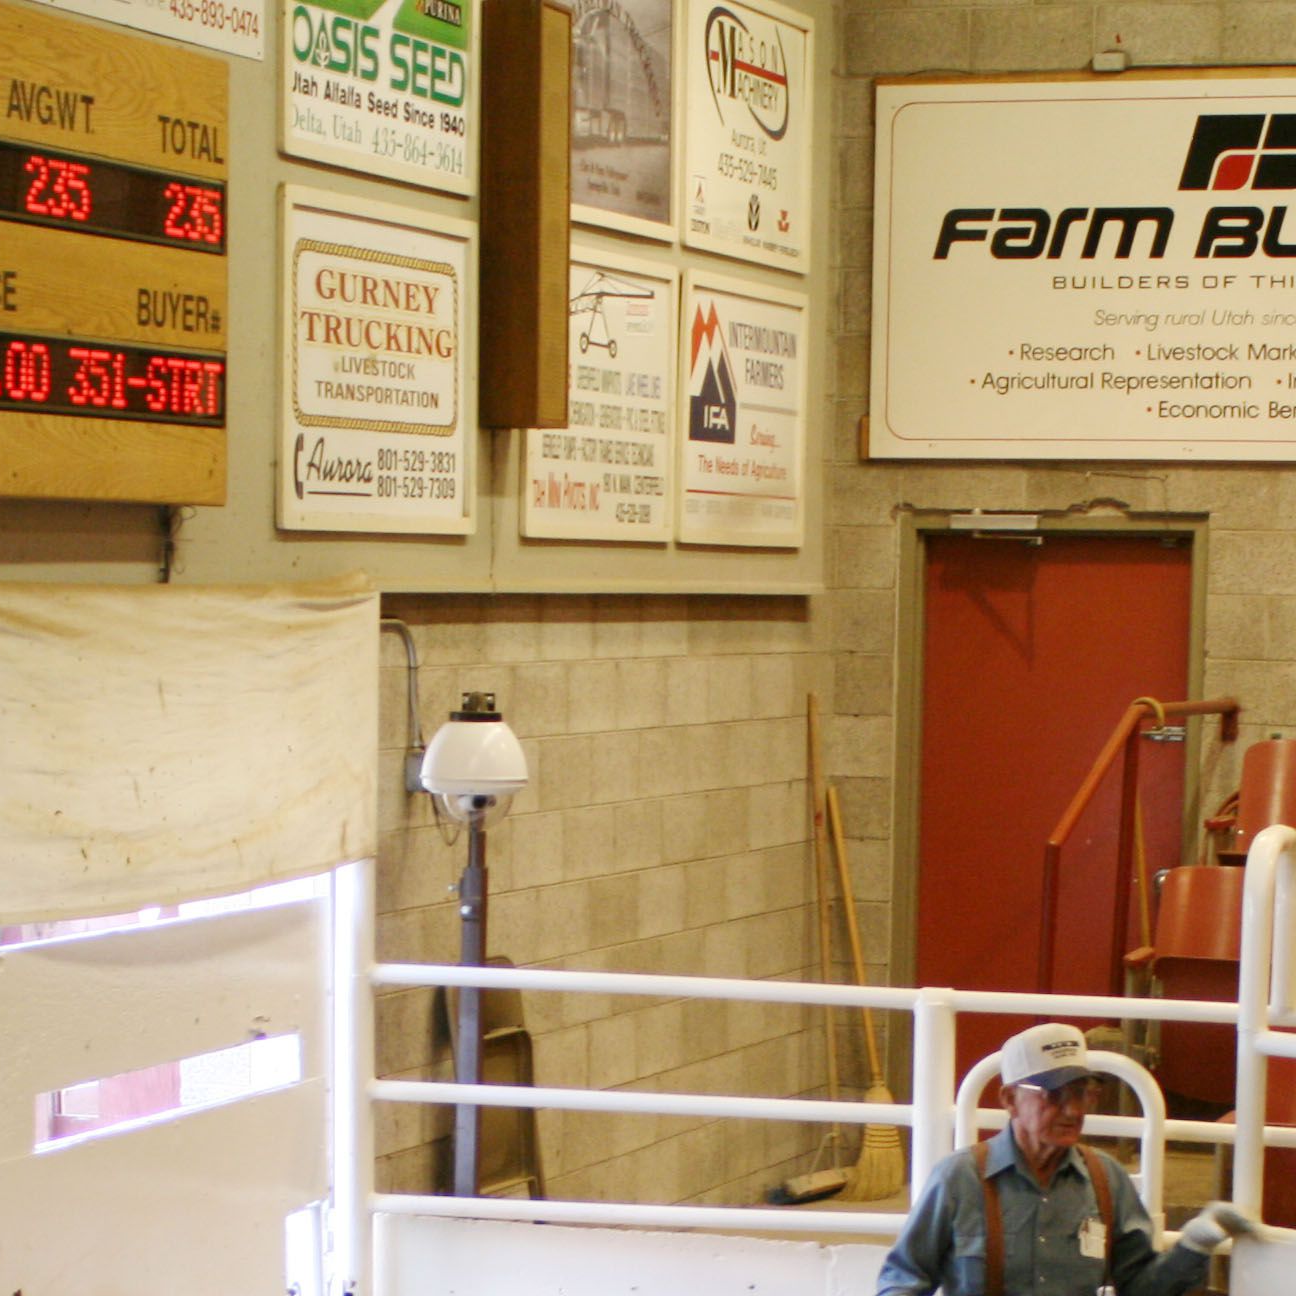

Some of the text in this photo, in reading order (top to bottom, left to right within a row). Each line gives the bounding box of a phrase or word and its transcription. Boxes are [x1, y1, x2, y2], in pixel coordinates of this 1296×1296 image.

[292, 5, 465, 108] OASIS SEED
[324, 79, 361, 109] Alfalfa
[367, 92, 398, 119] Seed
[404, 101, 435, 129] Since
[440, 112, 465, 138] 1940
[158, 115, 225, 165] TOTAL
[333, 114, 363, 145] Utah
[371, 127, 463, 175] 435-864-3614
[315, 268, 440, 315] GURNEY
[1052, 275, 1191, 290] BUILDERS
[1202, 275, 1238, 290] OF
[137, 288, 222, 333] BUYER#
[1093, 308, 1160, 332] Serving
[1164, 309, 1205, 327] rural
[1211, 309, 1255, 327] Utah
[300, 310, 454, 358] TRUCKING
[1019, 343, 1115, 361] Research
[1146, 343, 1240, 361] Livestock
[341, 356, 415, 380] LIVESTOCK
[744, 357, 785, 391] FARMERS
[315, 380, 439, 409] TRANSPORTATION
[981, 372, 1094, 395] Agricultural
[1101, 372, 1252, 394] Representation
[704, 404, 731, 431] IFA
[1158, 400, 1261, 419] Economic
[306, 436, 373, 484] Aurora
[377, 448, 455, 474] 801-529-3831
[377, 475, 455, 500] 801-529-7309
